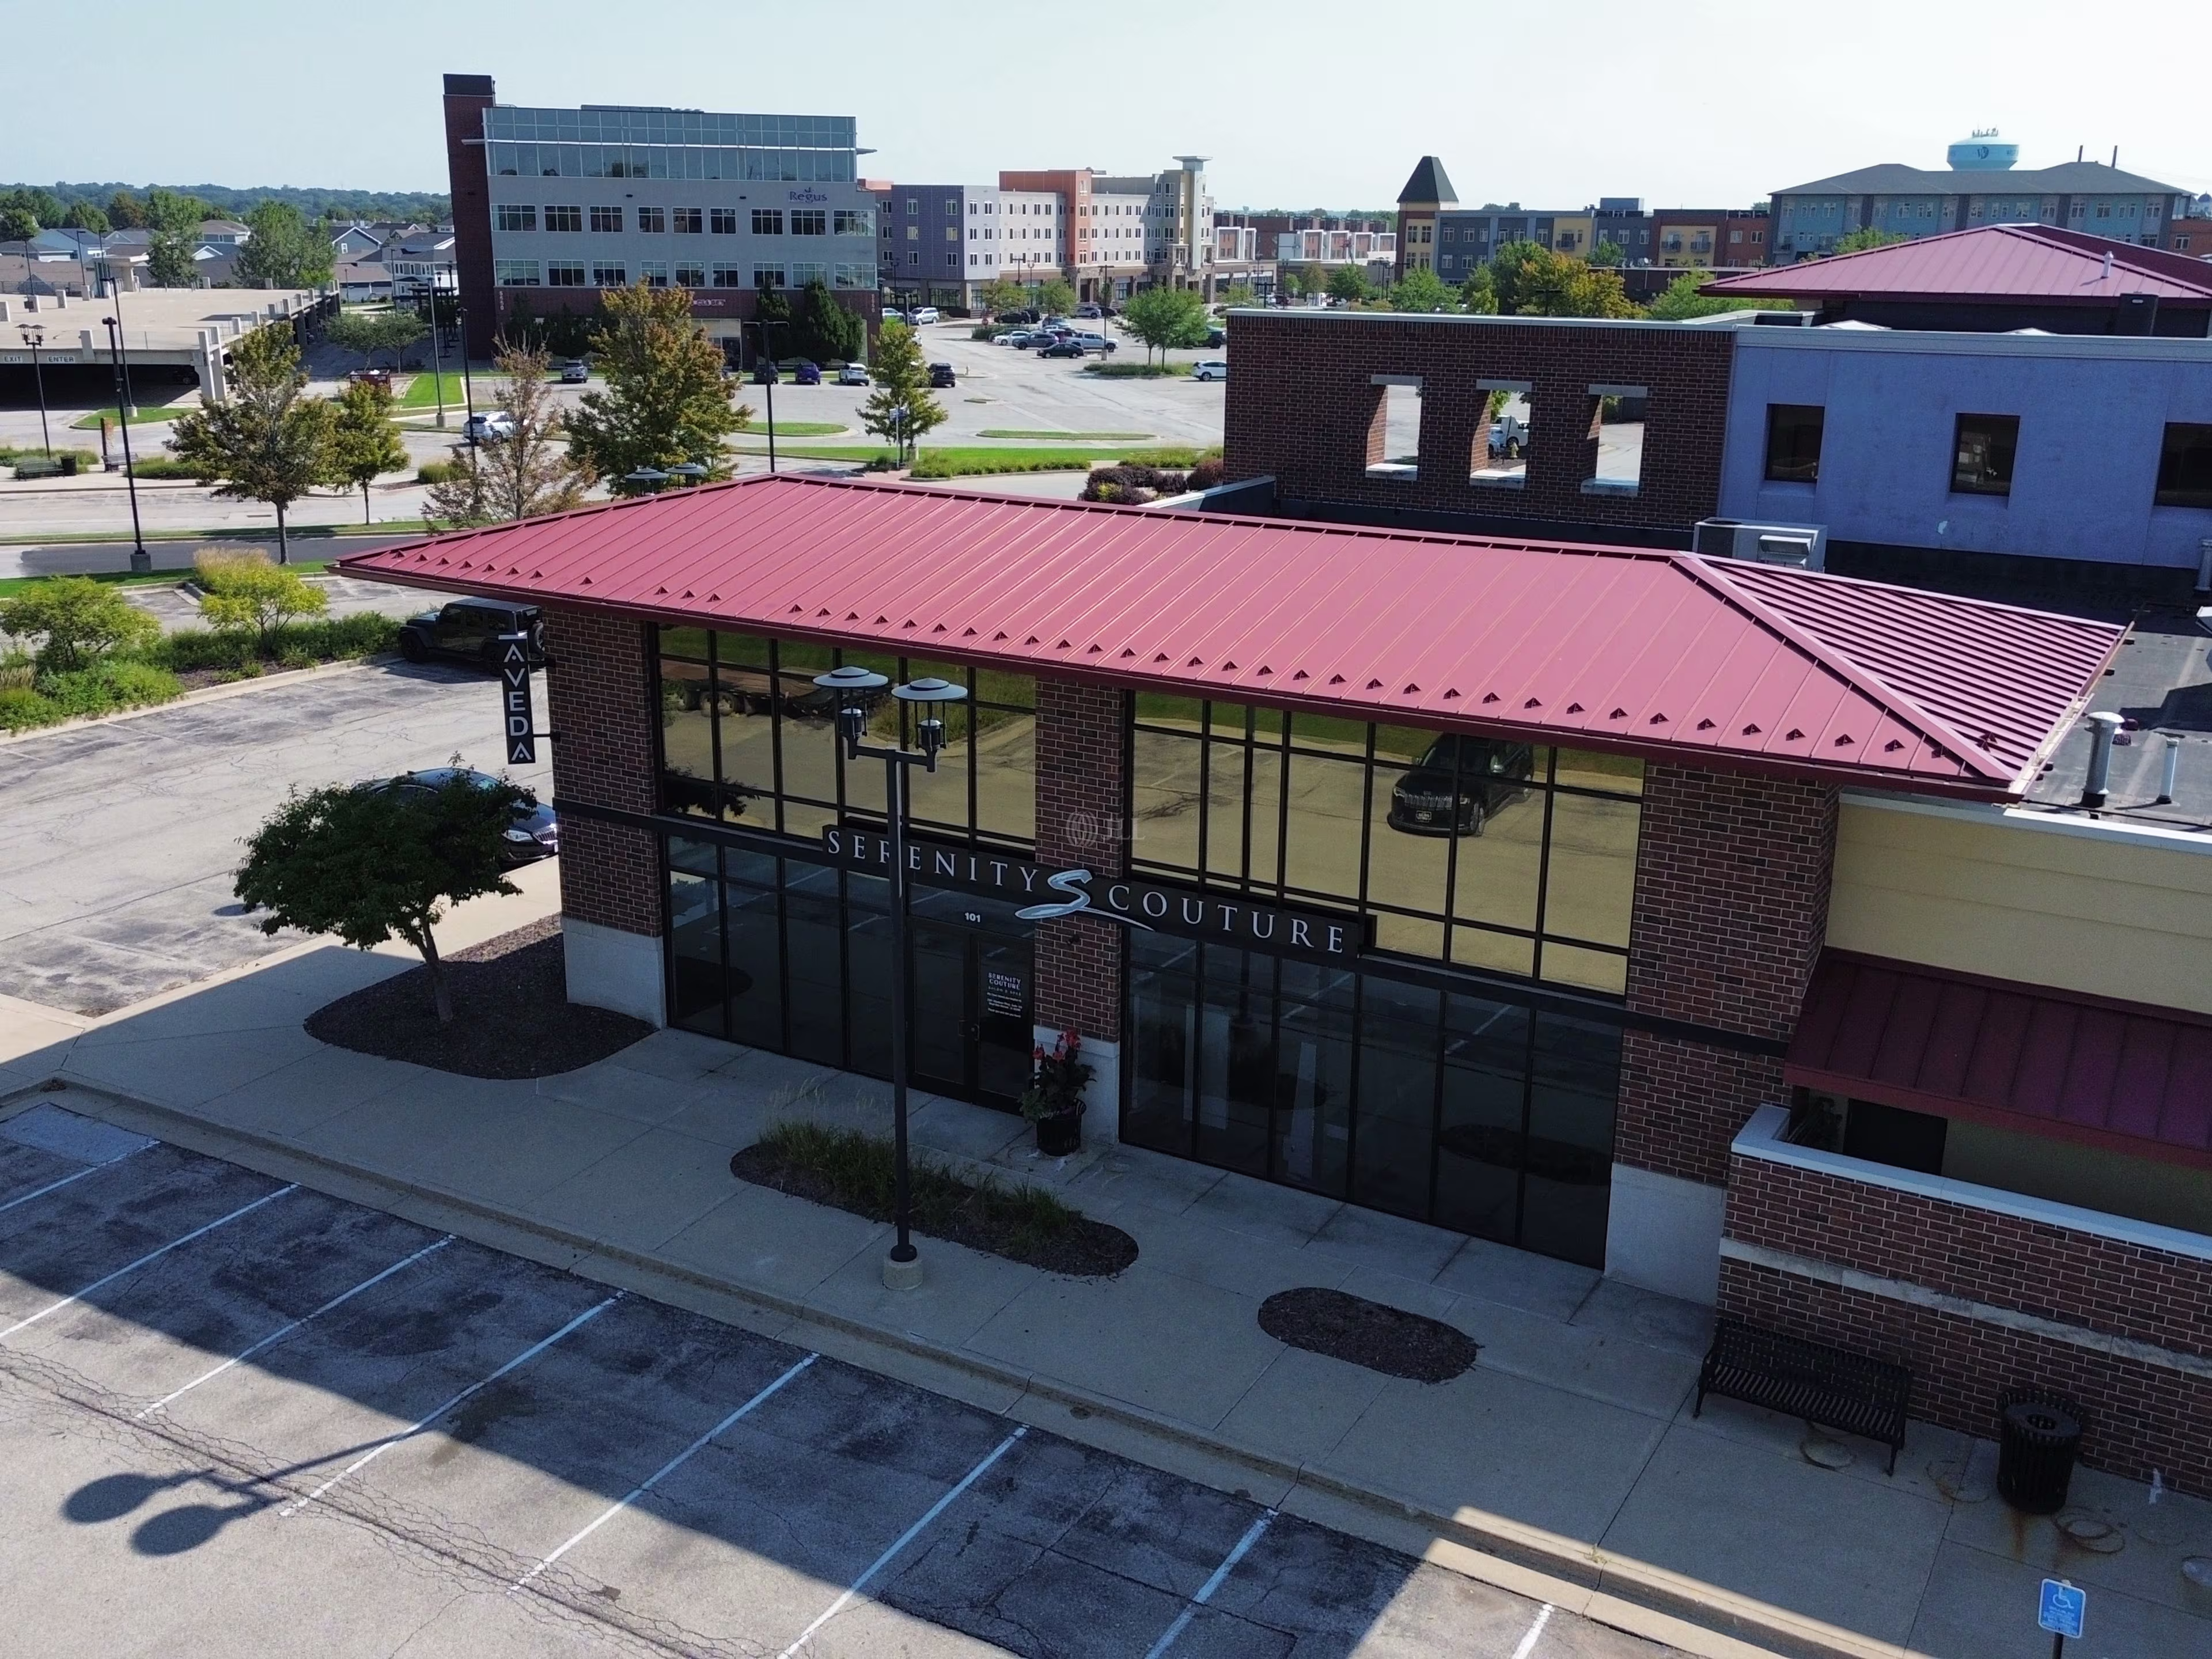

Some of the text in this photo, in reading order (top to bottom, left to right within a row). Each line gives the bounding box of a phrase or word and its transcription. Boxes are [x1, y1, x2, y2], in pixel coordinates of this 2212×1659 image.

[790, 191, 827, 204] Regus
[503, 643, 532, 762] AVEDA
[965, 912, 980, 923] 101
[1108, 885, 1343, 953] COUTURE
[988, 972, 1021, 984] SERENITY
[989, 979, 1020, 990] COUTURE
